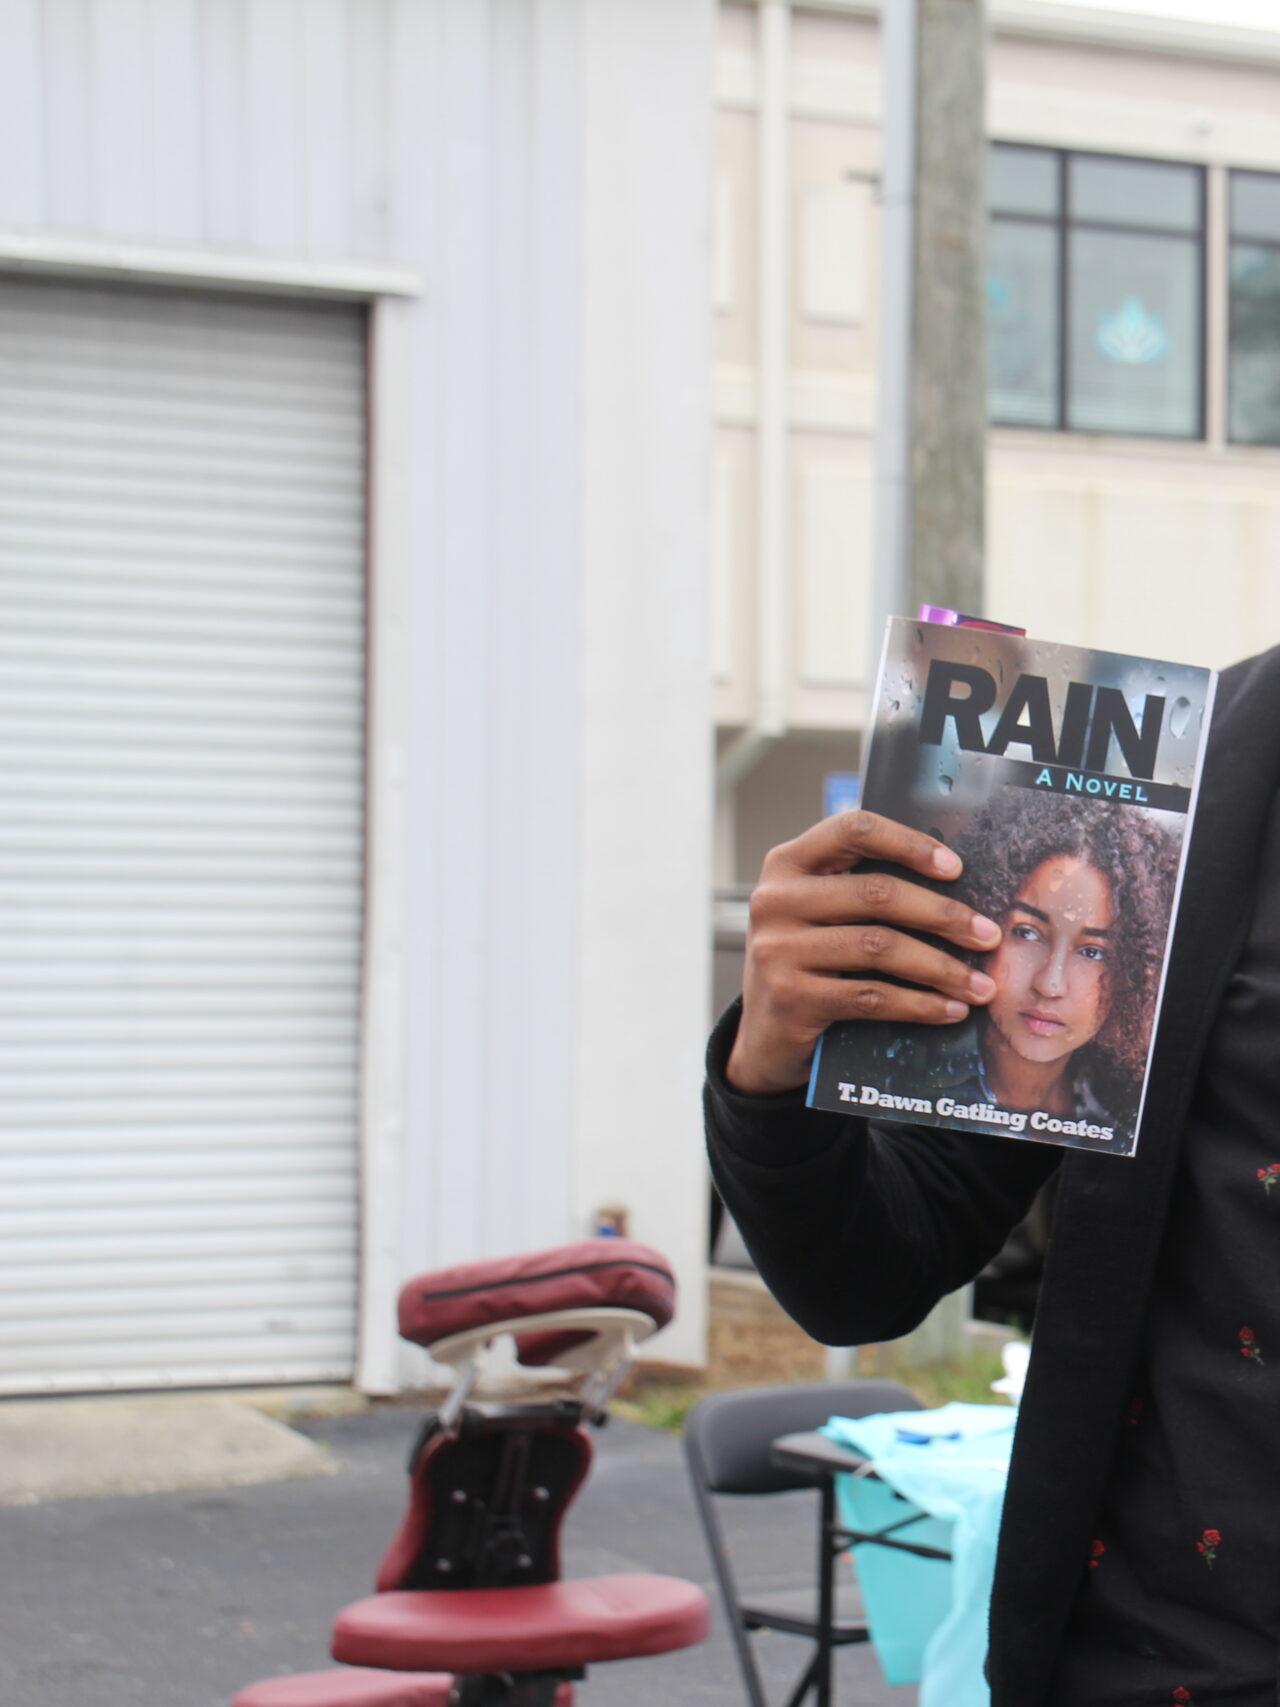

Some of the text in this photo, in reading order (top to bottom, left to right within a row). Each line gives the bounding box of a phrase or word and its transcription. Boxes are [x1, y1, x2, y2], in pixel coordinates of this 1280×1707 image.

[919, 659, 1165, 780] RAIN
[1035, 769, 1052, 786] A
[936, 1098, 1028, 1131] Gatling
[1030, 1111, 1114, 1141] Coates
